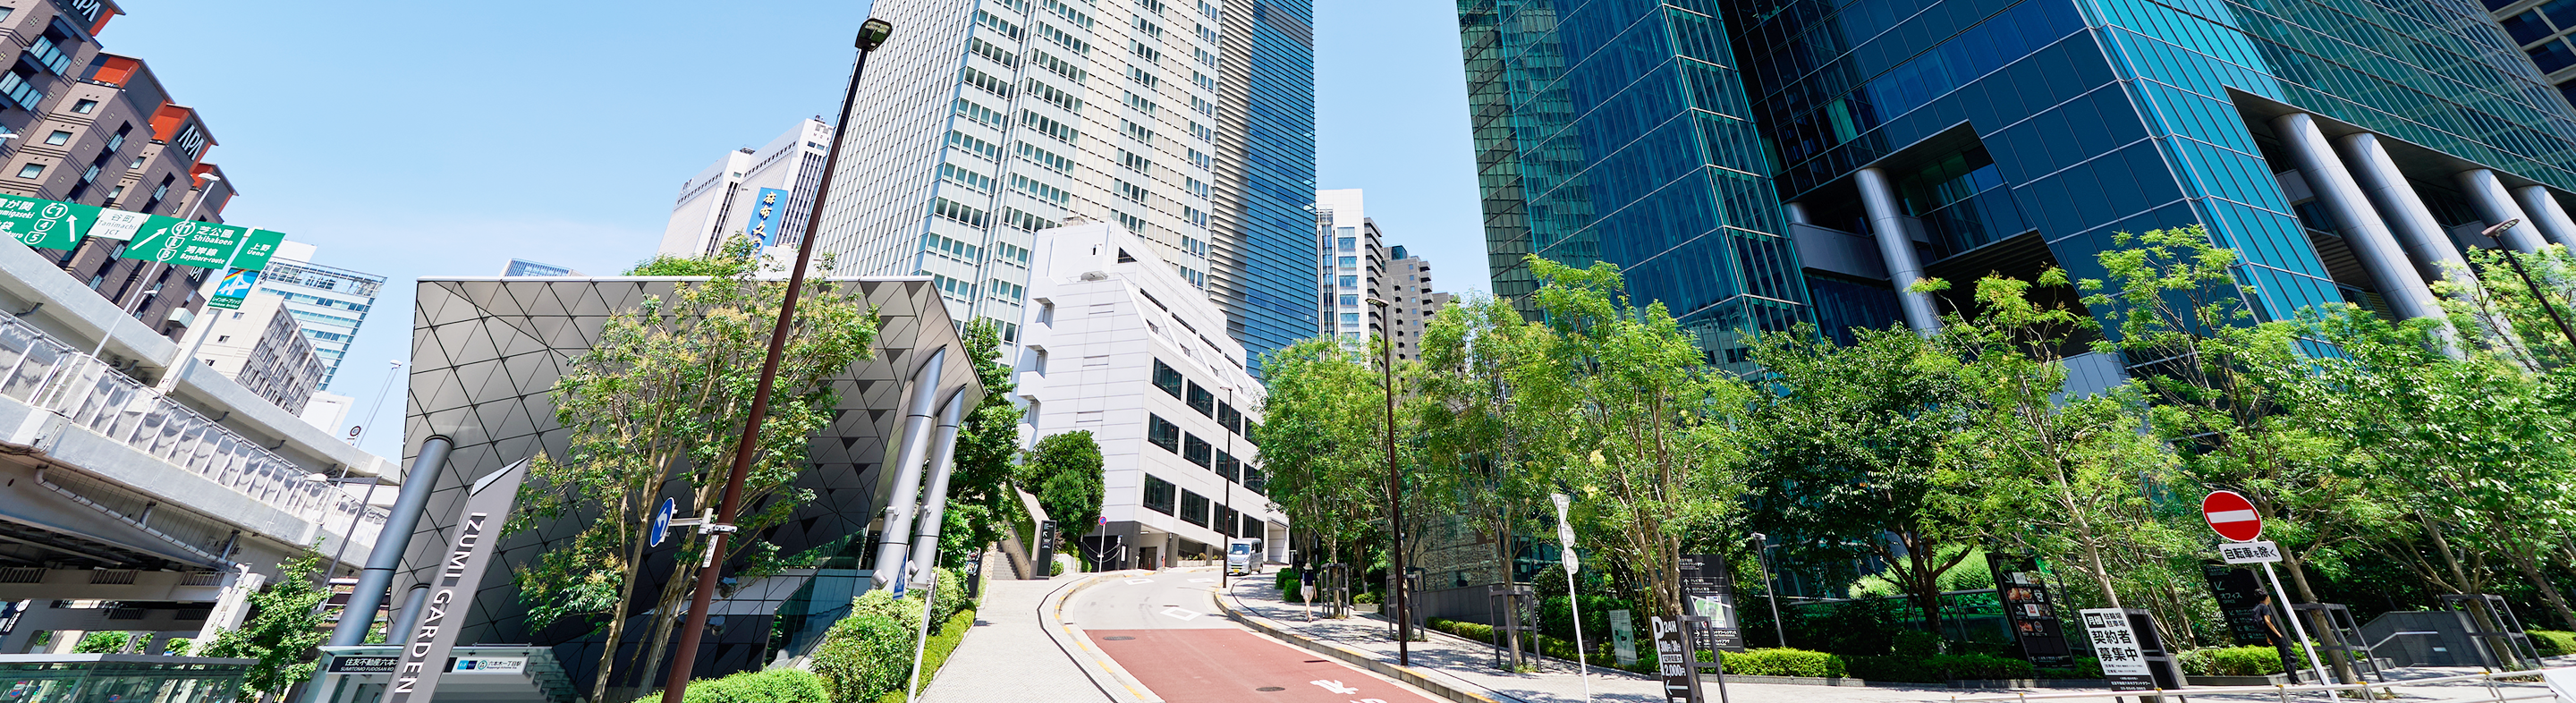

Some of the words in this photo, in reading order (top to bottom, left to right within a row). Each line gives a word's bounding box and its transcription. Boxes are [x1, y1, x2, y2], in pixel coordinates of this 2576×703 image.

[72, 0, 101, 22] PA
[177, 124, 205, 161] APA
[0, 220, 14, 230] 袋
[39, 221, 49, 229] 4
[98, 220, 138, 230] Tanimachi
[112, 214, 135, 223] 谷町
[197, 225, 234, 238] 芝公園
[192, 234, 233, 246] Shibakoen
[184, 245, 218, 256] 湾岸線
[250, 243, 271, 252] 上野
[180, 253, 225, 264] Bayshore-route
[445, 512, 487, 577] IZUMI
[2224, 546, 2277, 560] 自転車を除く
[1664, 620, 1678, 633] 24H
[394, 589, 453, 693] GARDEN
[2091, 630, 2131, 644] 契約者
[1651, 615, 1665, 676] P
[2098, 647, 2139, 662] 募集中
[1665, 664, 1686, 677] 2,000円
